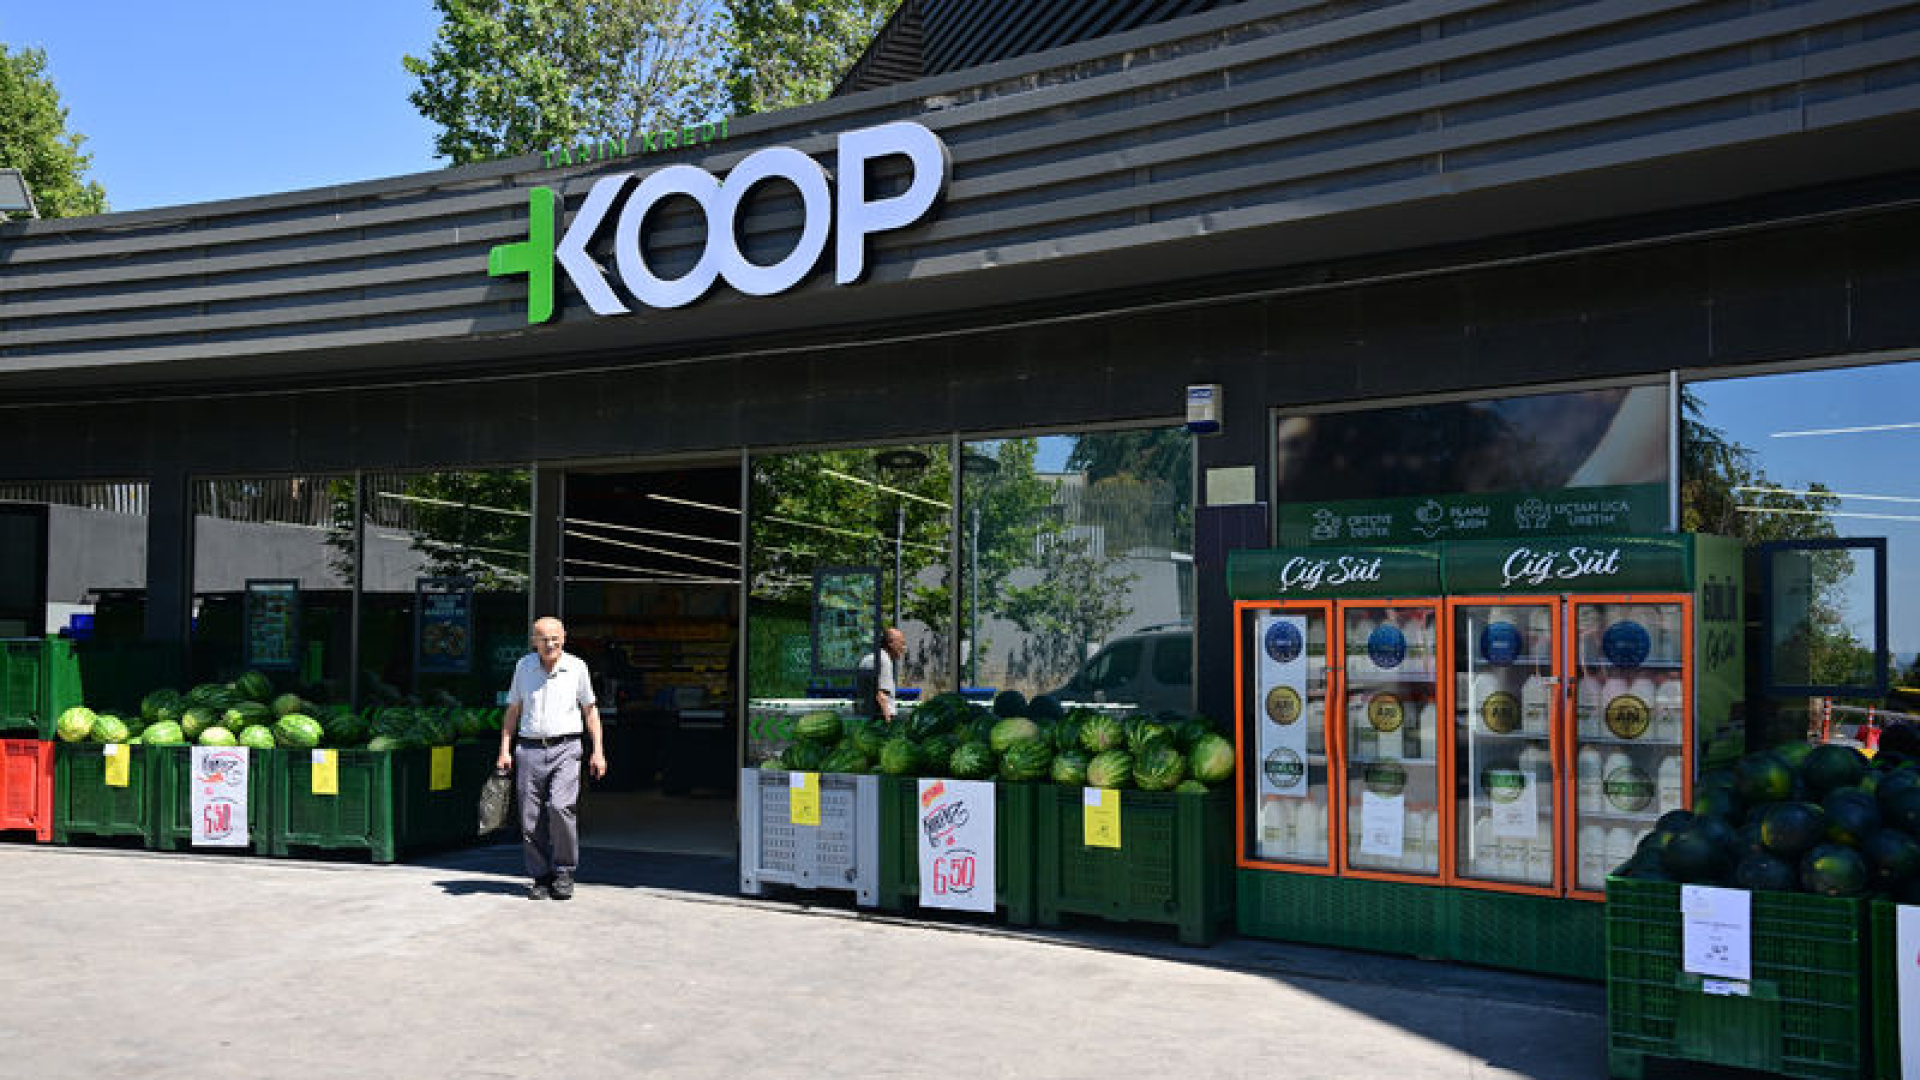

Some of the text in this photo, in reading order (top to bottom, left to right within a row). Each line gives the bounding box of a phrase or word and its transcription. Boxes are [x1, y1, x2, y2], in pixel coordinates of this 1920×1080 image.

[556, 121, 946, 317] KOOP
[1279, 555, 1382, 593] Çiğ Süt
[1501, 546, 1621, 589] Çiğ Süt
